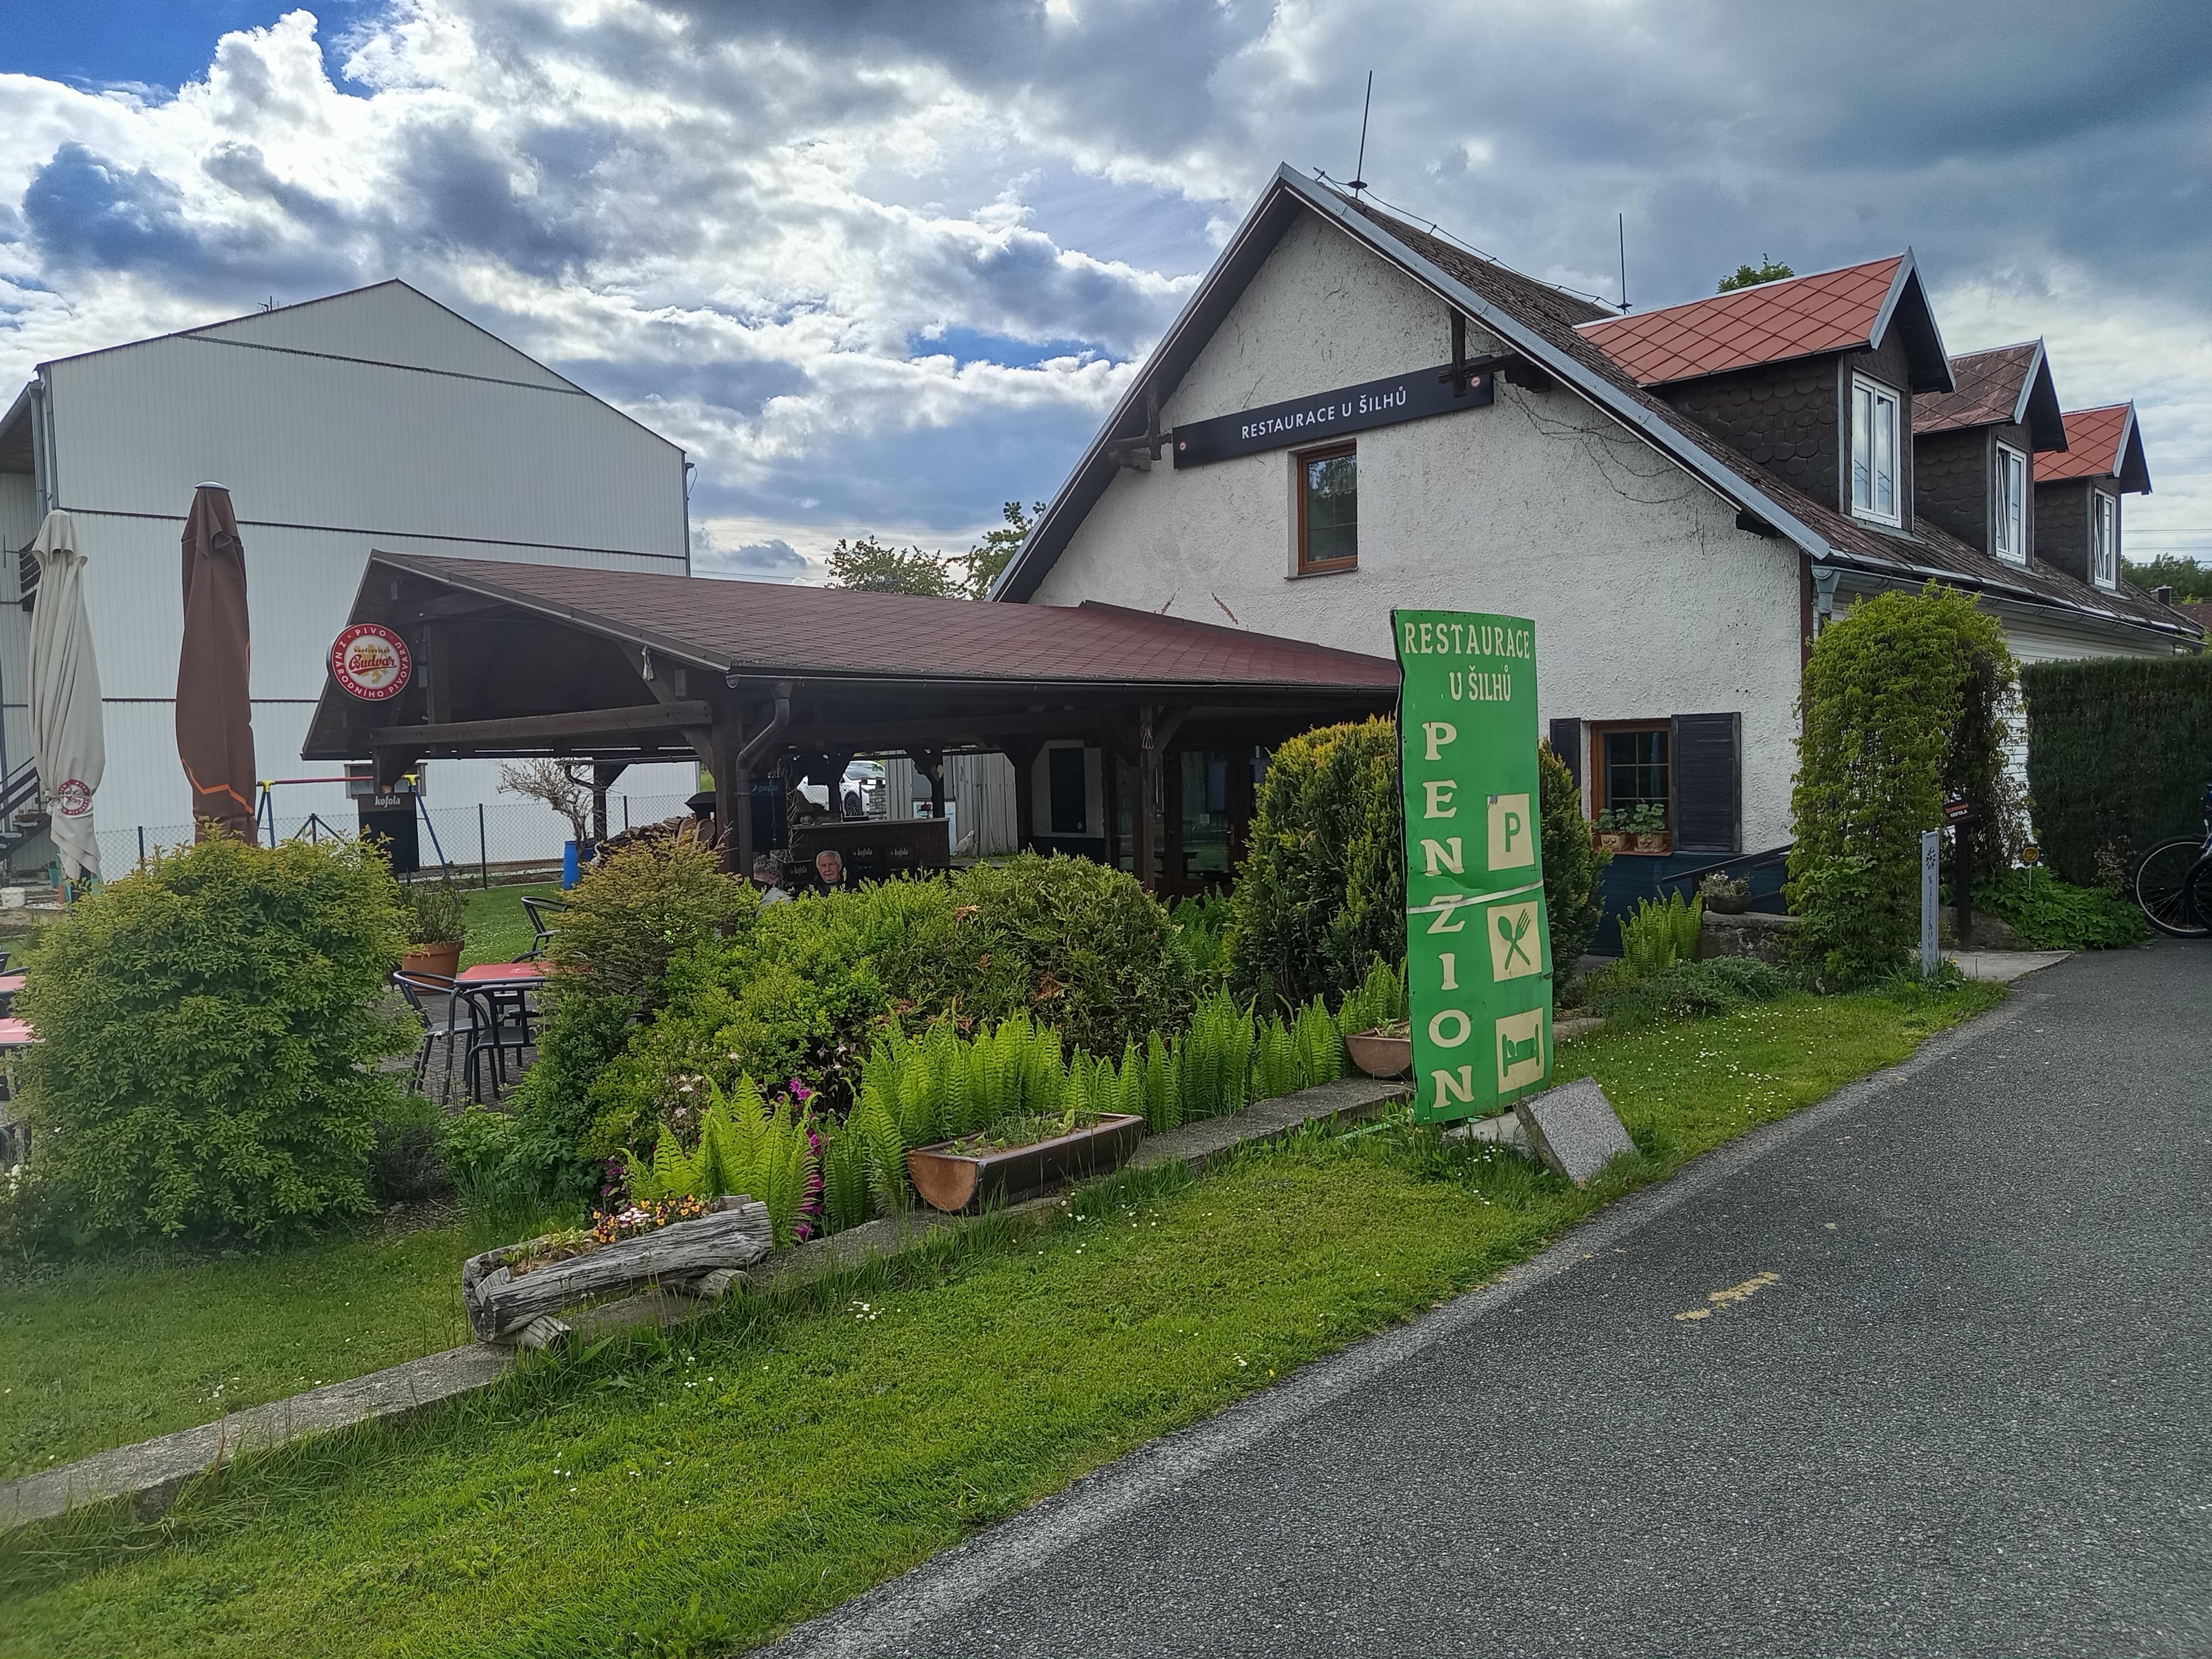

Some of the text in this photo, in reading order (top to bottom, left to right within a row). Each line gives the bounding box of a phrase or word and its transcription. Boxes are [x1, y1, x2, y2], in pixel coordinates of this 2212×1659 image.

[1241, 386, 1407, 440] RESTAURACE U ŠILHŮ
[355, 627, 386, 637] PIVO
[1404, 623, 1530, 659] RESTAURACE
[335, 651, 384, 698] NÁRODNÍHO
[388, 641, 409, 693] PIVOVARU
[348, 654, 395, 670] Budvar
[1449, 665, 1511, 702] U ŠILHŮ
[374, 795, 401, 808] kofola
[1950, 809, 1968, 817] KOFOLA
[1505, 812, 1521, 853] P
[857, 848, 873, 857] kofola
[894, 848, 908, 857] kofola
[1419, 721, 1475, 1108] PENZION
